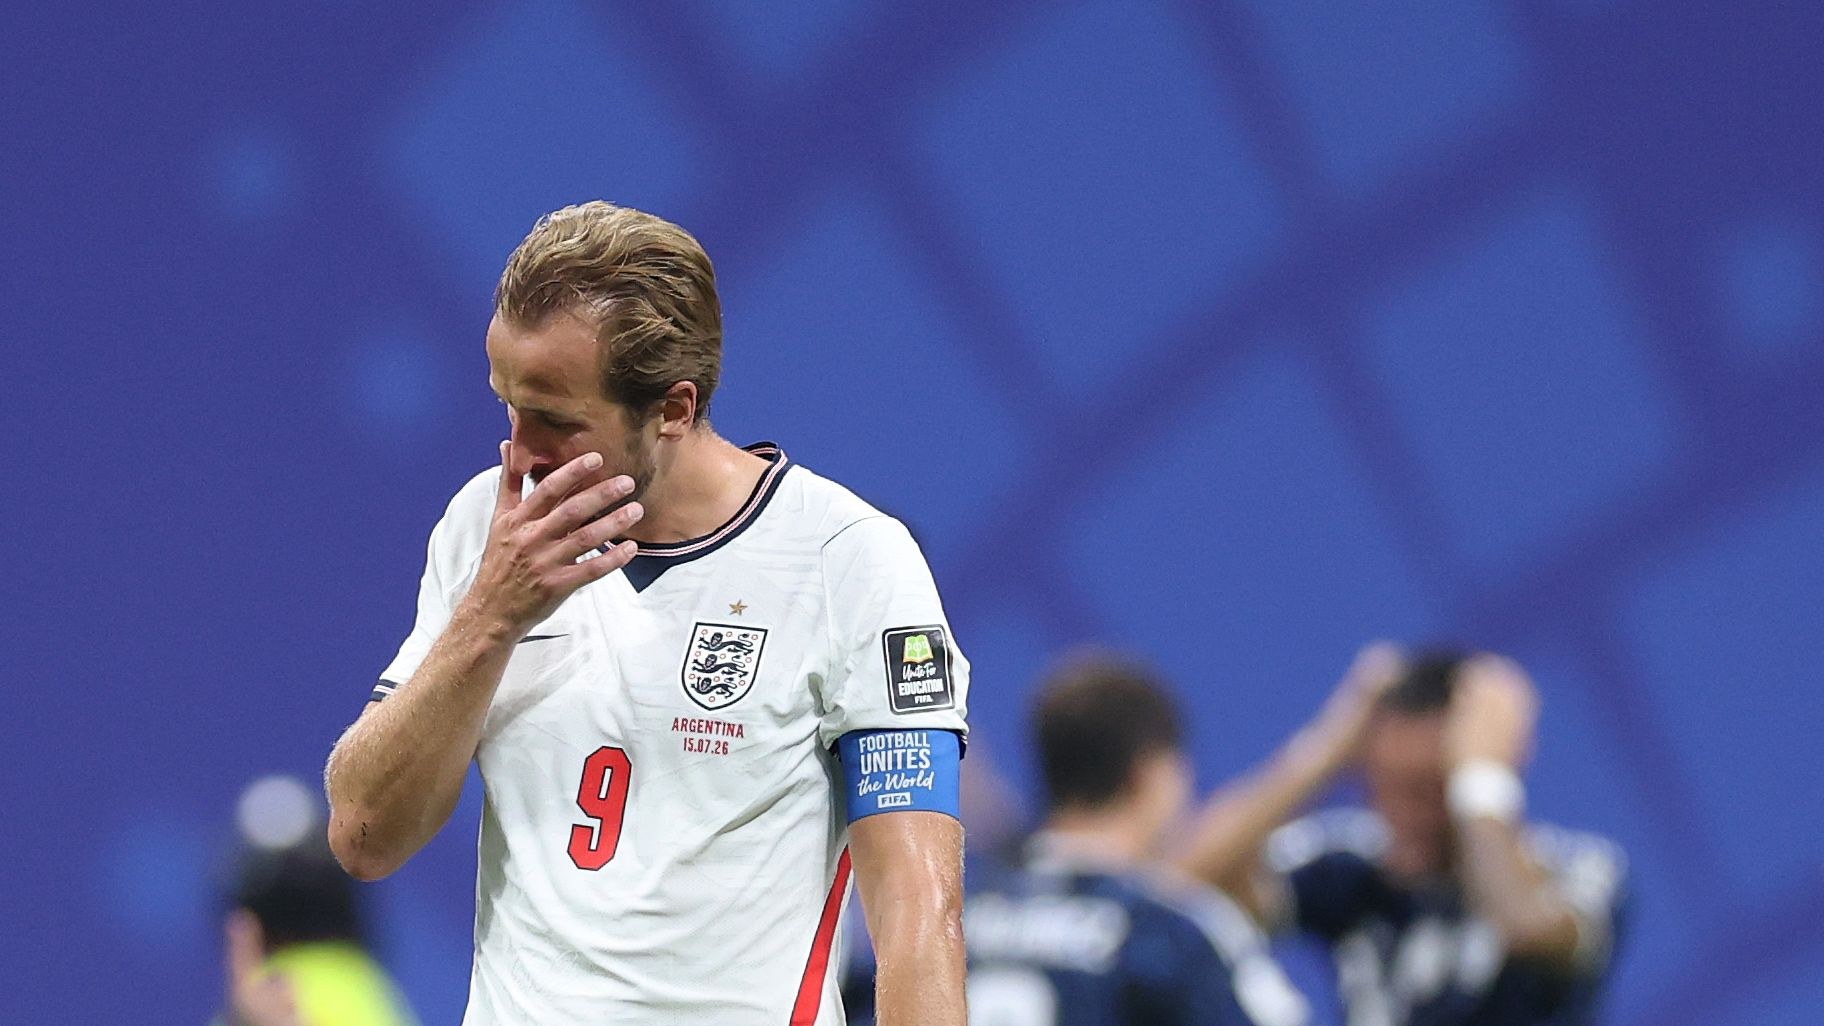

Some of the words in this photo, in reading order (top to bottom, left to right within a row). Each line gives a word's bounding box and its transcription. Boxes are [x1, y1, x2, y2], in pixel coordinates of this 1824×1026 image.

[898, 678, 944, 696] EDUCATION
[671, 717, 744, 738] ARGENTINA
[683, 737, 729, 755] 15.07.26
[858, 732, 930, 753] FOOTBALL
[860, 748, 931, 775] UNITES
[857, 775, 882, 797] the
[884, 769, 935, 791] World
[567, 746, 632, 871] 9
[881, 795, 908, 804] FIFA
